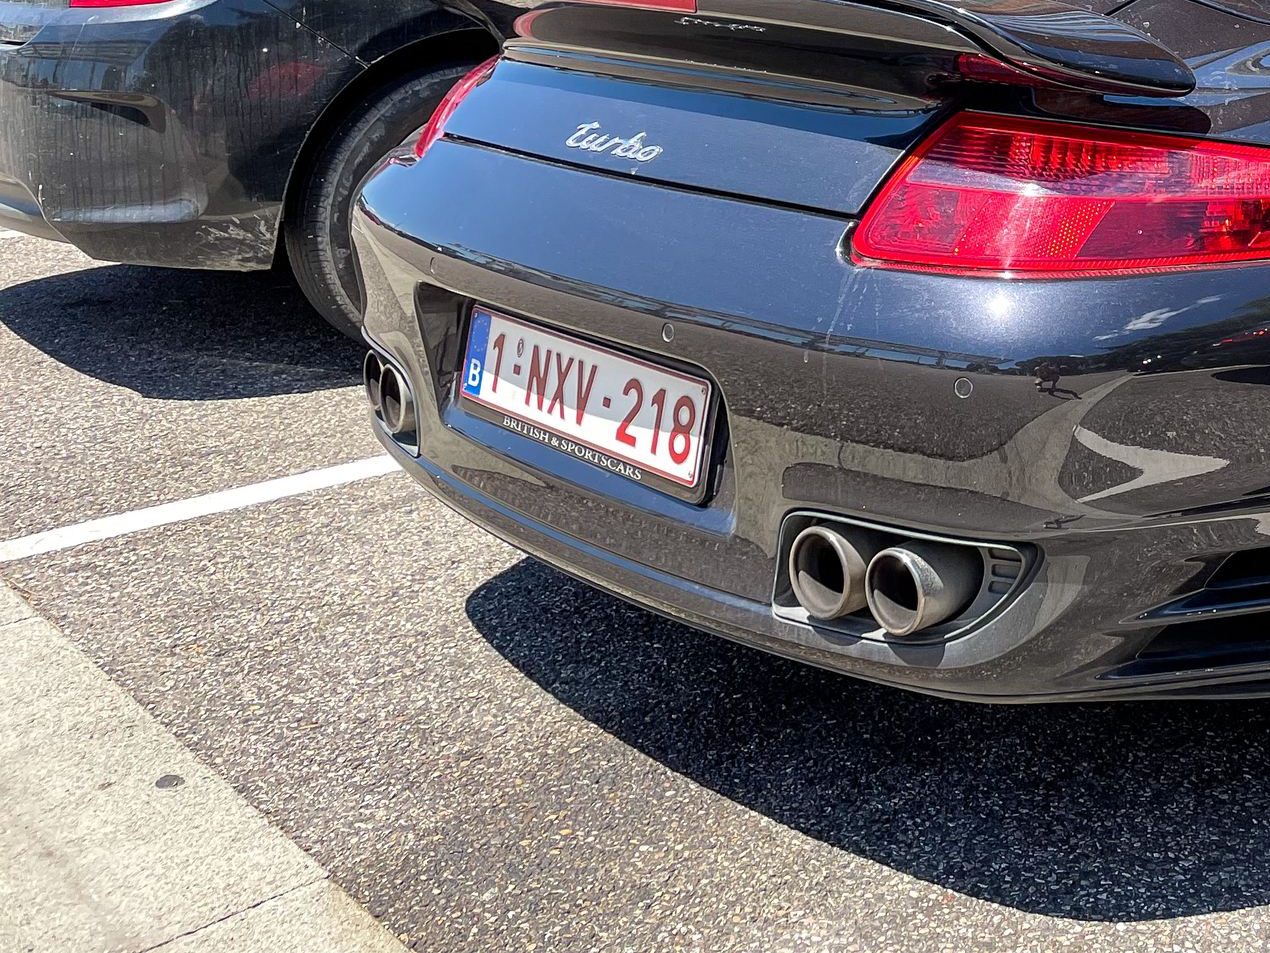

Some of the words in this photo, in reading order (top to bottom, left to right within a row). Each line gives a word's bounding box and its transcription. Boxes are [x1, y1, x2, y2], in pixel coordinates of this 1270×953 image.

[564, 120, 664, 163] turbo
[467, 358, 482, 388] B
[502, 414, 550, 444] BRITISH
[550, 435, 560, 448] &
[560, 439, 643, 481] SPORTSCARS
